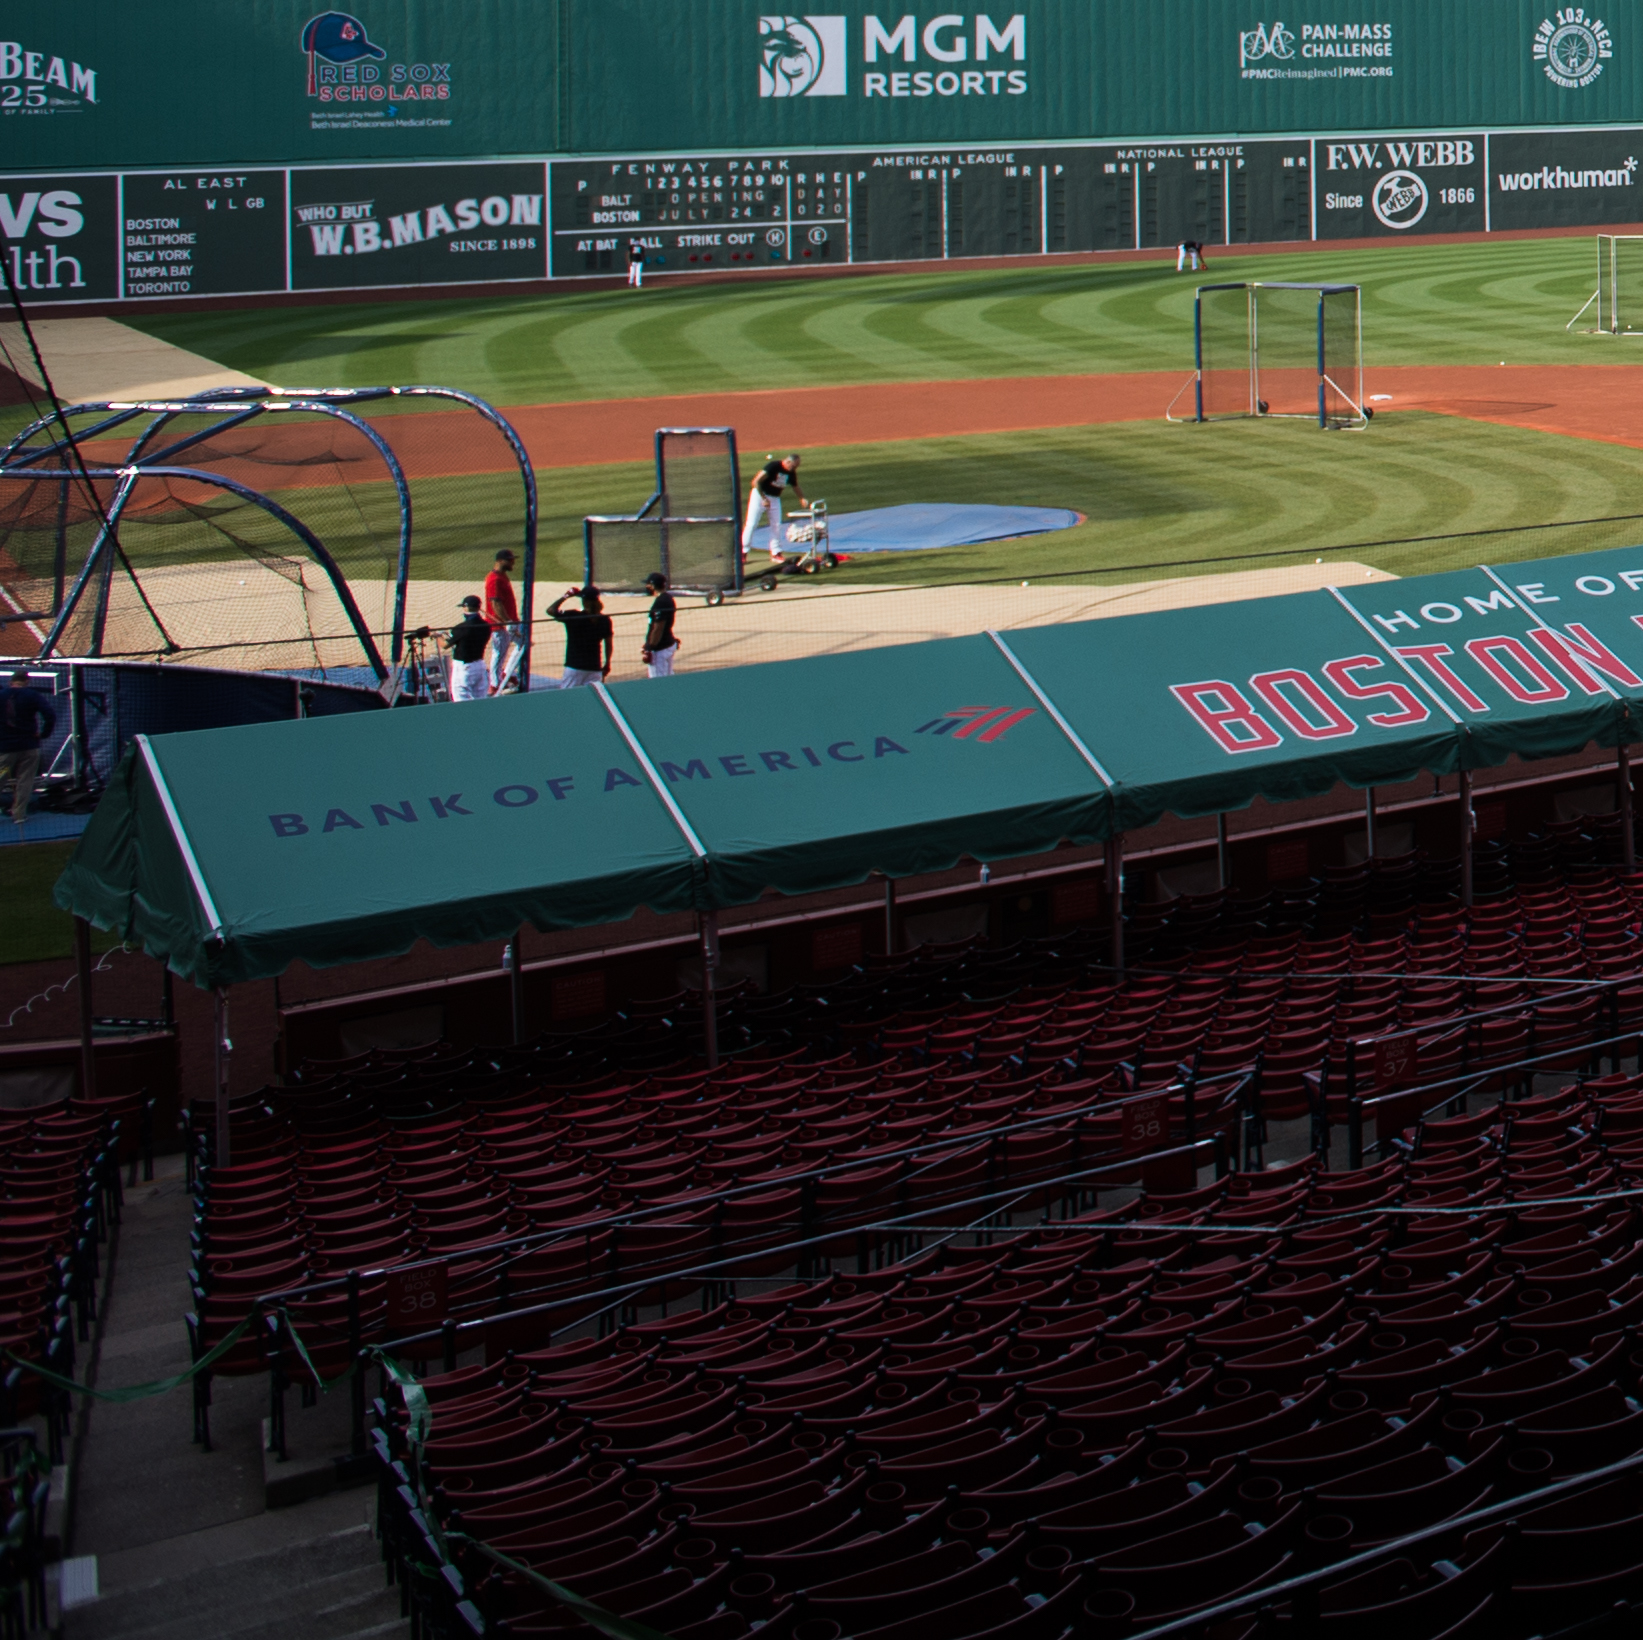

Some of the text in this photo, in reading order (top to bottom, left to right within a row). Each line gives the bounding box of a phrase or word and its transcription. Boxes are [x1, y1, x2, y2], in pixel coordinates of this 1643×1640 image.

[864, 14, 1026, 61] MGM
[1302, 24, 1392, 40] PAN-MASS
[1533, 19, 1556, 60] IBEW
[1556, 7, 1584, 26] 103
[1590, 19, 1613, 58] NECA
[1302, 43, 1393, 58] CHALLENGE
[0, 42, 98, 105] BEAM
[320, 63, 451, 83] RED SOX
[864, 70, 1028, 97] RESORTS
[1, 85, 48, 106] 25
[319, 84, 452, 101] SCHOLARS
[872, 153, 1014, 167] AMERICAN LEAGUE
[1117, 146, 1243, 159] NATIONAL LEAGUE
[1326, 141, 1475, 170] F.W. WEBB
[164, 177, 247, 189] AL EAST
[206, 198, 265, 210] W L GB
[601, 195, 631, 207] BALT
[1325, 193, 1363, 209] Since
[1386, 187, 1417, 212] WEBB
[1439, 188, 1475, 204] 1866
[298, 204, 373, 221] WHO BUT
[592, 211, 640, 224] BOSTON
[126, 218, 180, 230] BOSTON
[126, 233, 197, 246] BALTIMORE
[450, 238, 536, 252] SINCE 1898
[578, 233, 755, 251] AT BAT STRIKE OUT
[127, 249, 191, 262] NEW YORK
[127, 265, 193, 278] TAMPA BAY
[128, 281, 190, 294] TORONTO
[1373, 572, 1556, 635] HOME
[269, 733, 911, 839] BANK OF AMERICA
[555, 976, 600, 991] CAUTION
[1382, 1059, 1409, 1078] 37
[1130, 1121, 1161, 1141] 38
[399, 1268, 437, 1282] FIELD
[404, 1280, 432, 1293] BOX
[402, 1291, 437, 1313] 38
